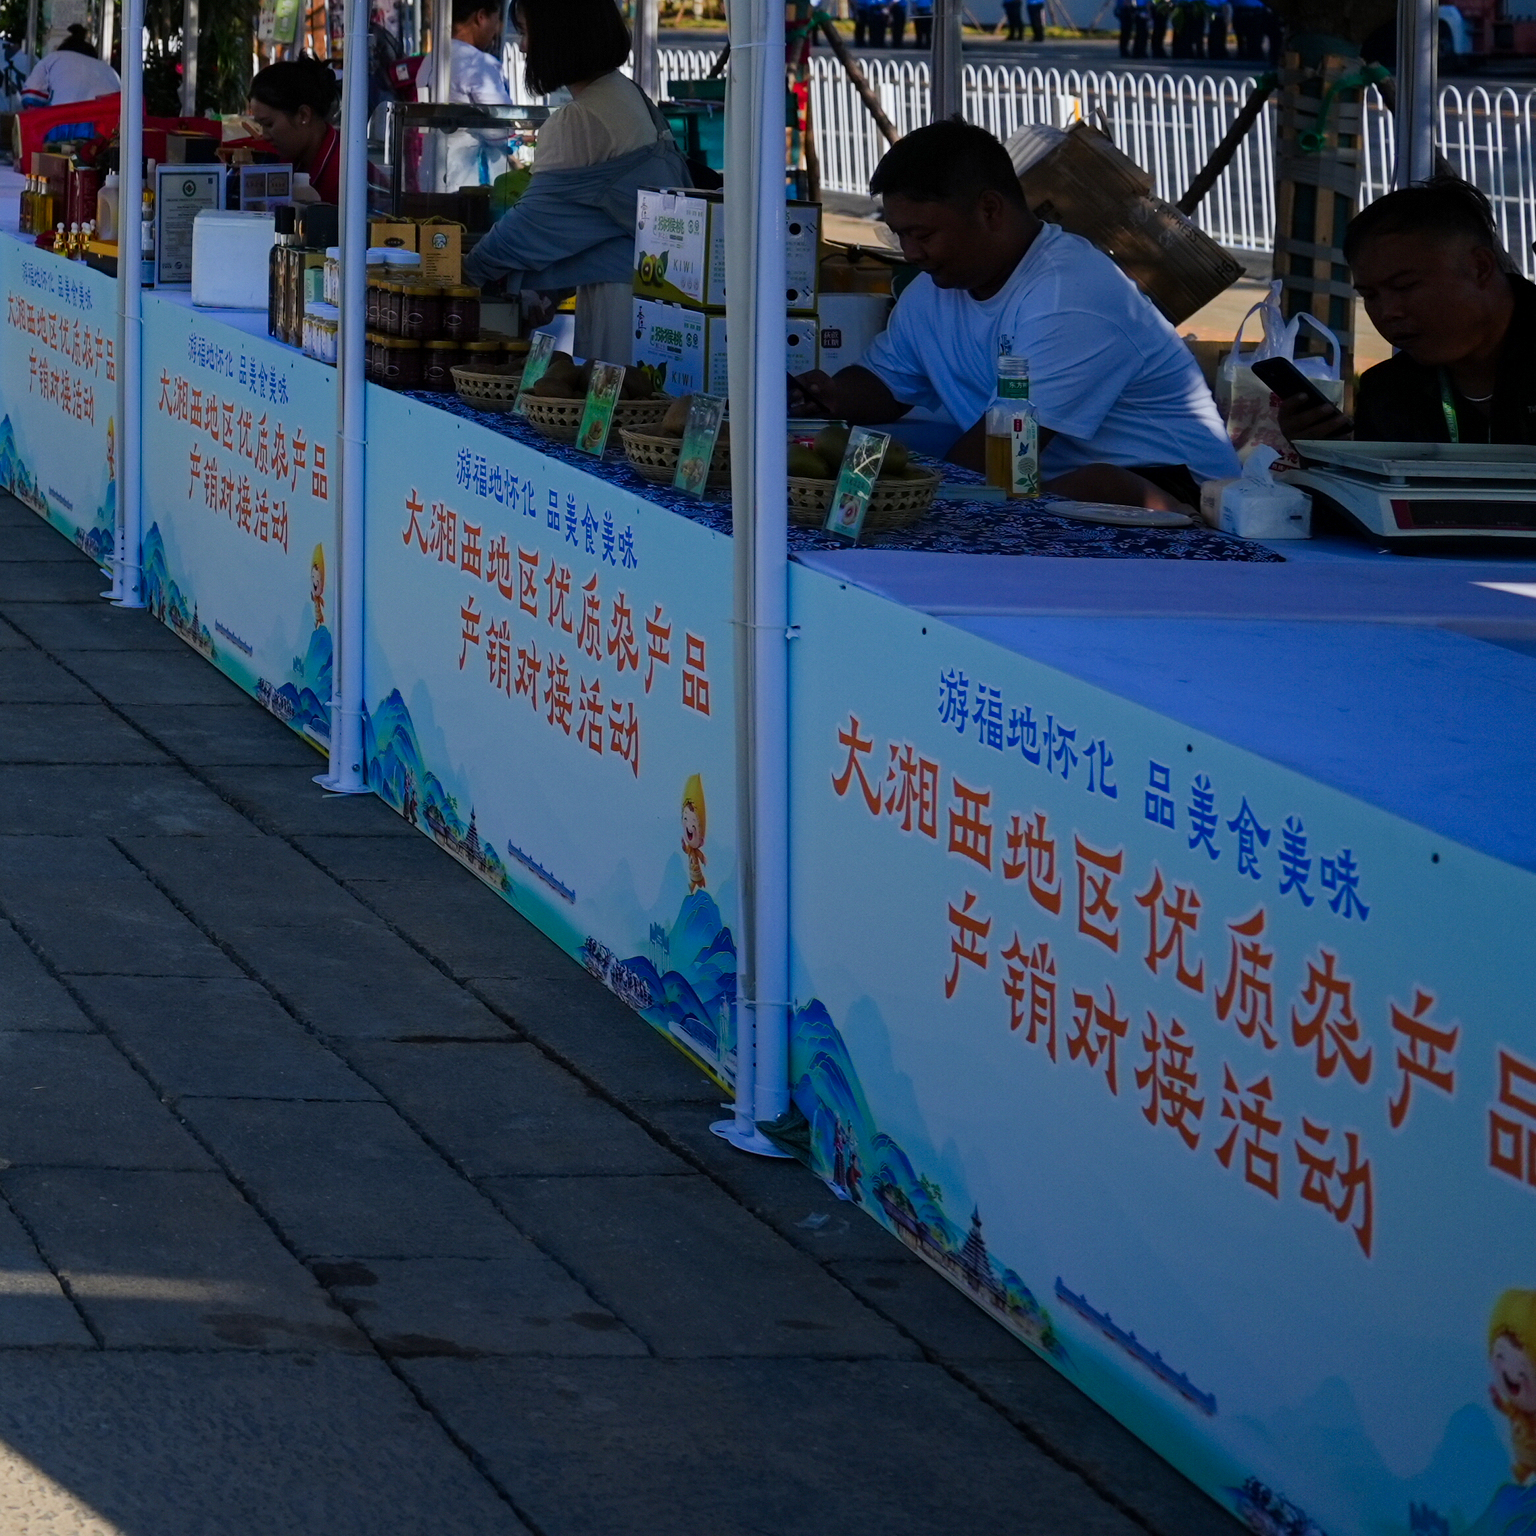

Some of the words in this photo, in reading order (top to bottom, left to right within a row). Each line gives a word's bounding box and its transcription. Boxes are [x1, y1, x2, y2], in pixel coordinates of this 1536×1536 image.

[673, 259, 693, 273] KIWI
[6, 291, 116, 383] 大湘西地区优质农产品
[28, 348, 95, 427] 产销对接活动
[187, 332, 234, 378] 游福地怀化
[238, 356, 290, 405] 品美食美味
[671, 373, 693, 387] KIWI
[157, 367, 330, 501] 大湘西地区优质农产品
[187, 441, 289, 555] 产销对接活动
[455, 446, 537, 520] 游福地怀化
[547, 486, 639, 571] 品美食美味
[401, 487, 711, 717] 大湘西地区优质农产品
[458, 595, 640, 779] 产销对接活动
[938, 668, 1118, 799] 游福地怀化
[1144, 757, 1371, 923] 品美食美味
[830, 712, 1536, 1188] 大湘西地区优质农产品
[944, 890, 1375, 1261] 产销对接活动
